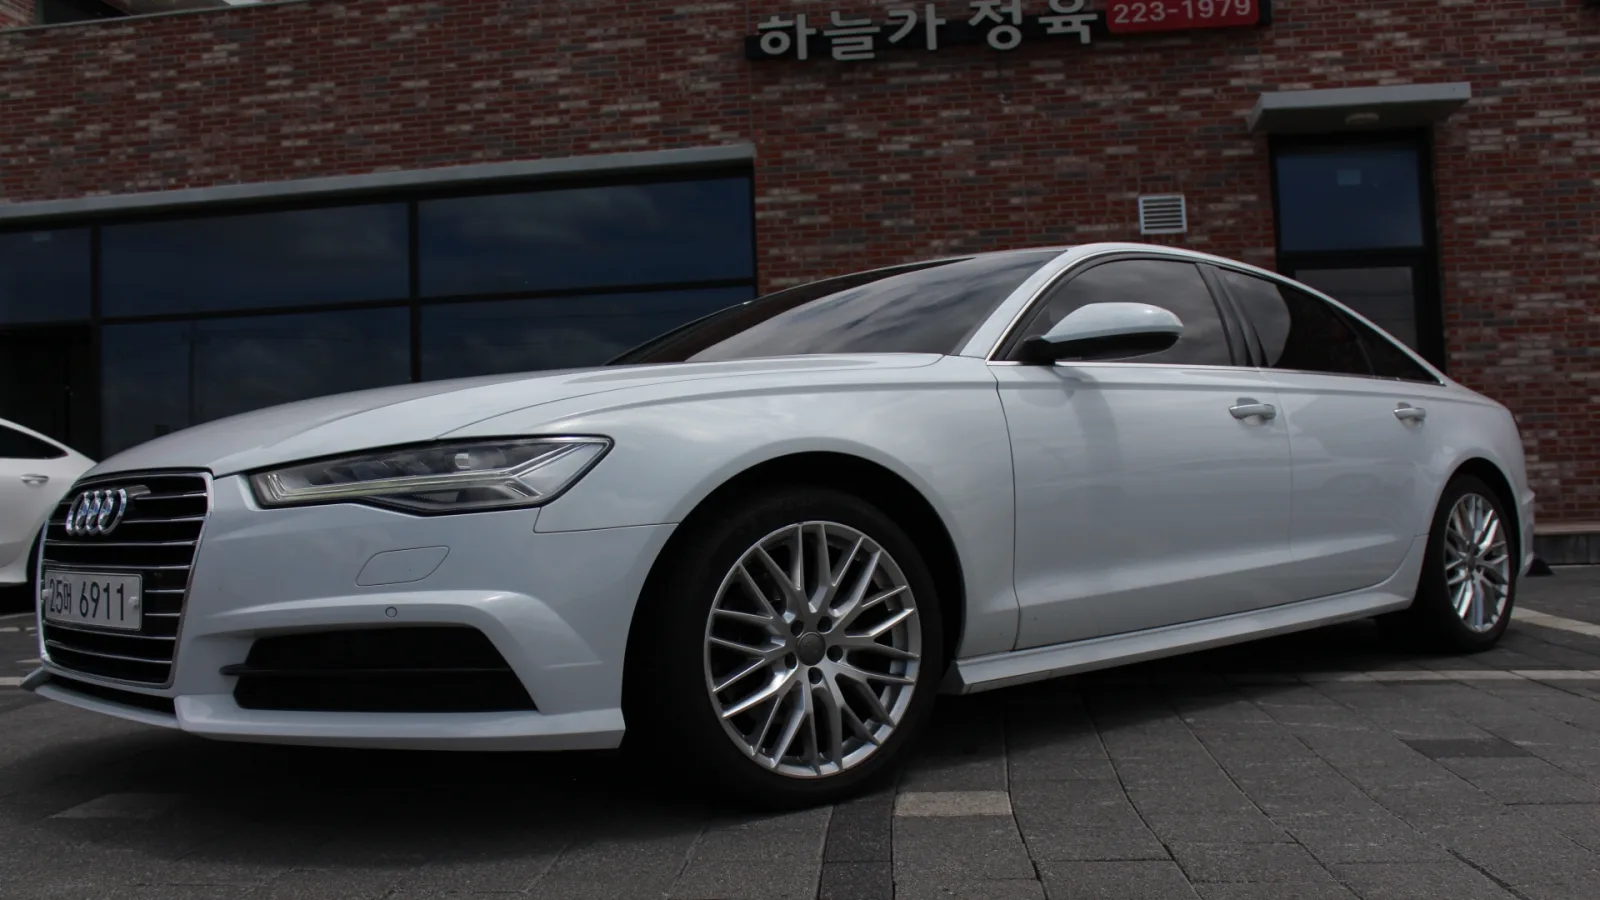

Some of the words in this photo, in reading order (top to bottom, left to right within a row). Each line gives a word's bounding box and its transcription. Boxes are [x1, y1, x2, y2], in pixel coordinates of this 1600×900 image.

[758, 3, 945, 61] 하늘가
[968, 0, 1097, 50] 정육
[1112, 0, 1252, 24] 223-1979
[50, 578, 72, 614] 25머
[79, 581, 125, 621] 6911
